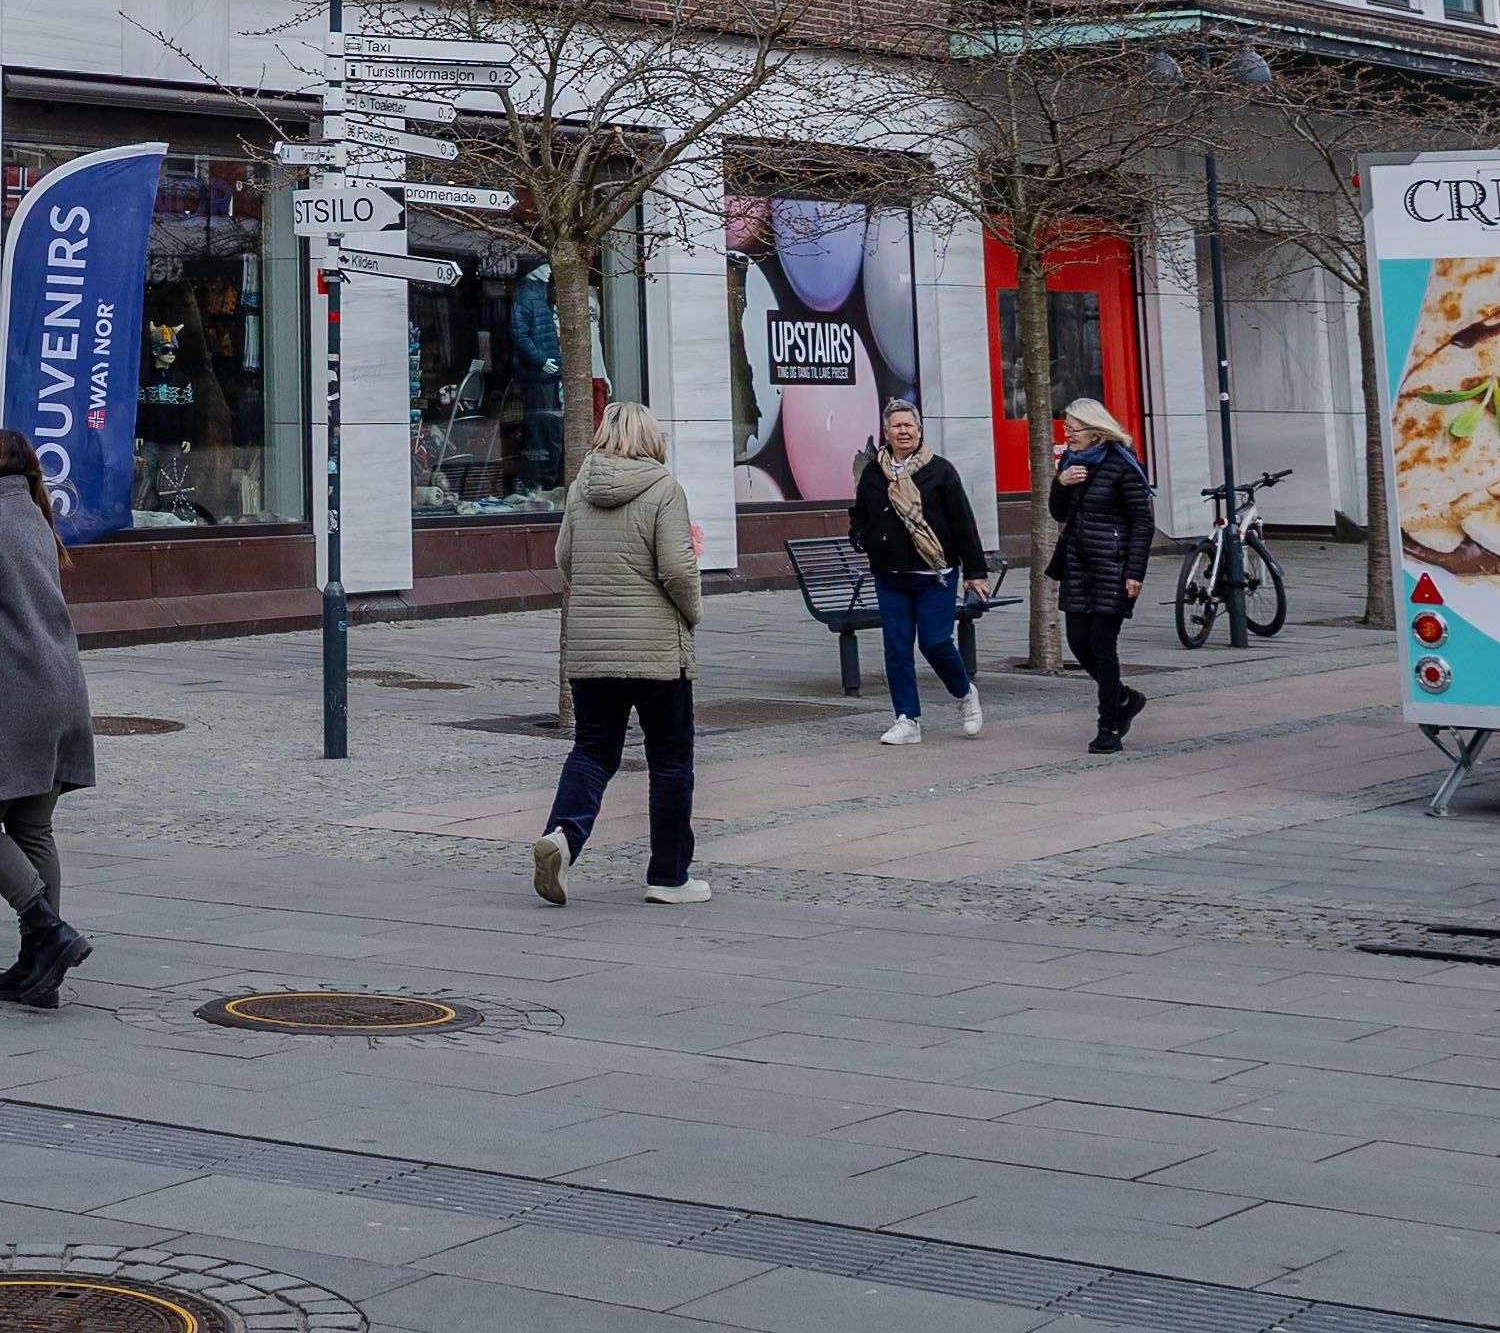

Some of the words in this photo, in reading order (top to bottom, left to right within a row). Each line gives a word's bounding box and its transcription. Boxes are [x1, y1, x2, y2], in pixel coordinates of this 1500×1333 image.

[366, 39, 391, 53] Taxi
[365, 65, 475, 83] Turistinformasjon
[369, 97, 408, 113] Toaletter
[358, 127, 400, 147] Posebyen
[351, 254, 379, 271] Kilden
[93, 303, 115, 355] NOR
[771, 321, 852, 364] UPSTAIRS
[89, 359, 109, 410] WAY
